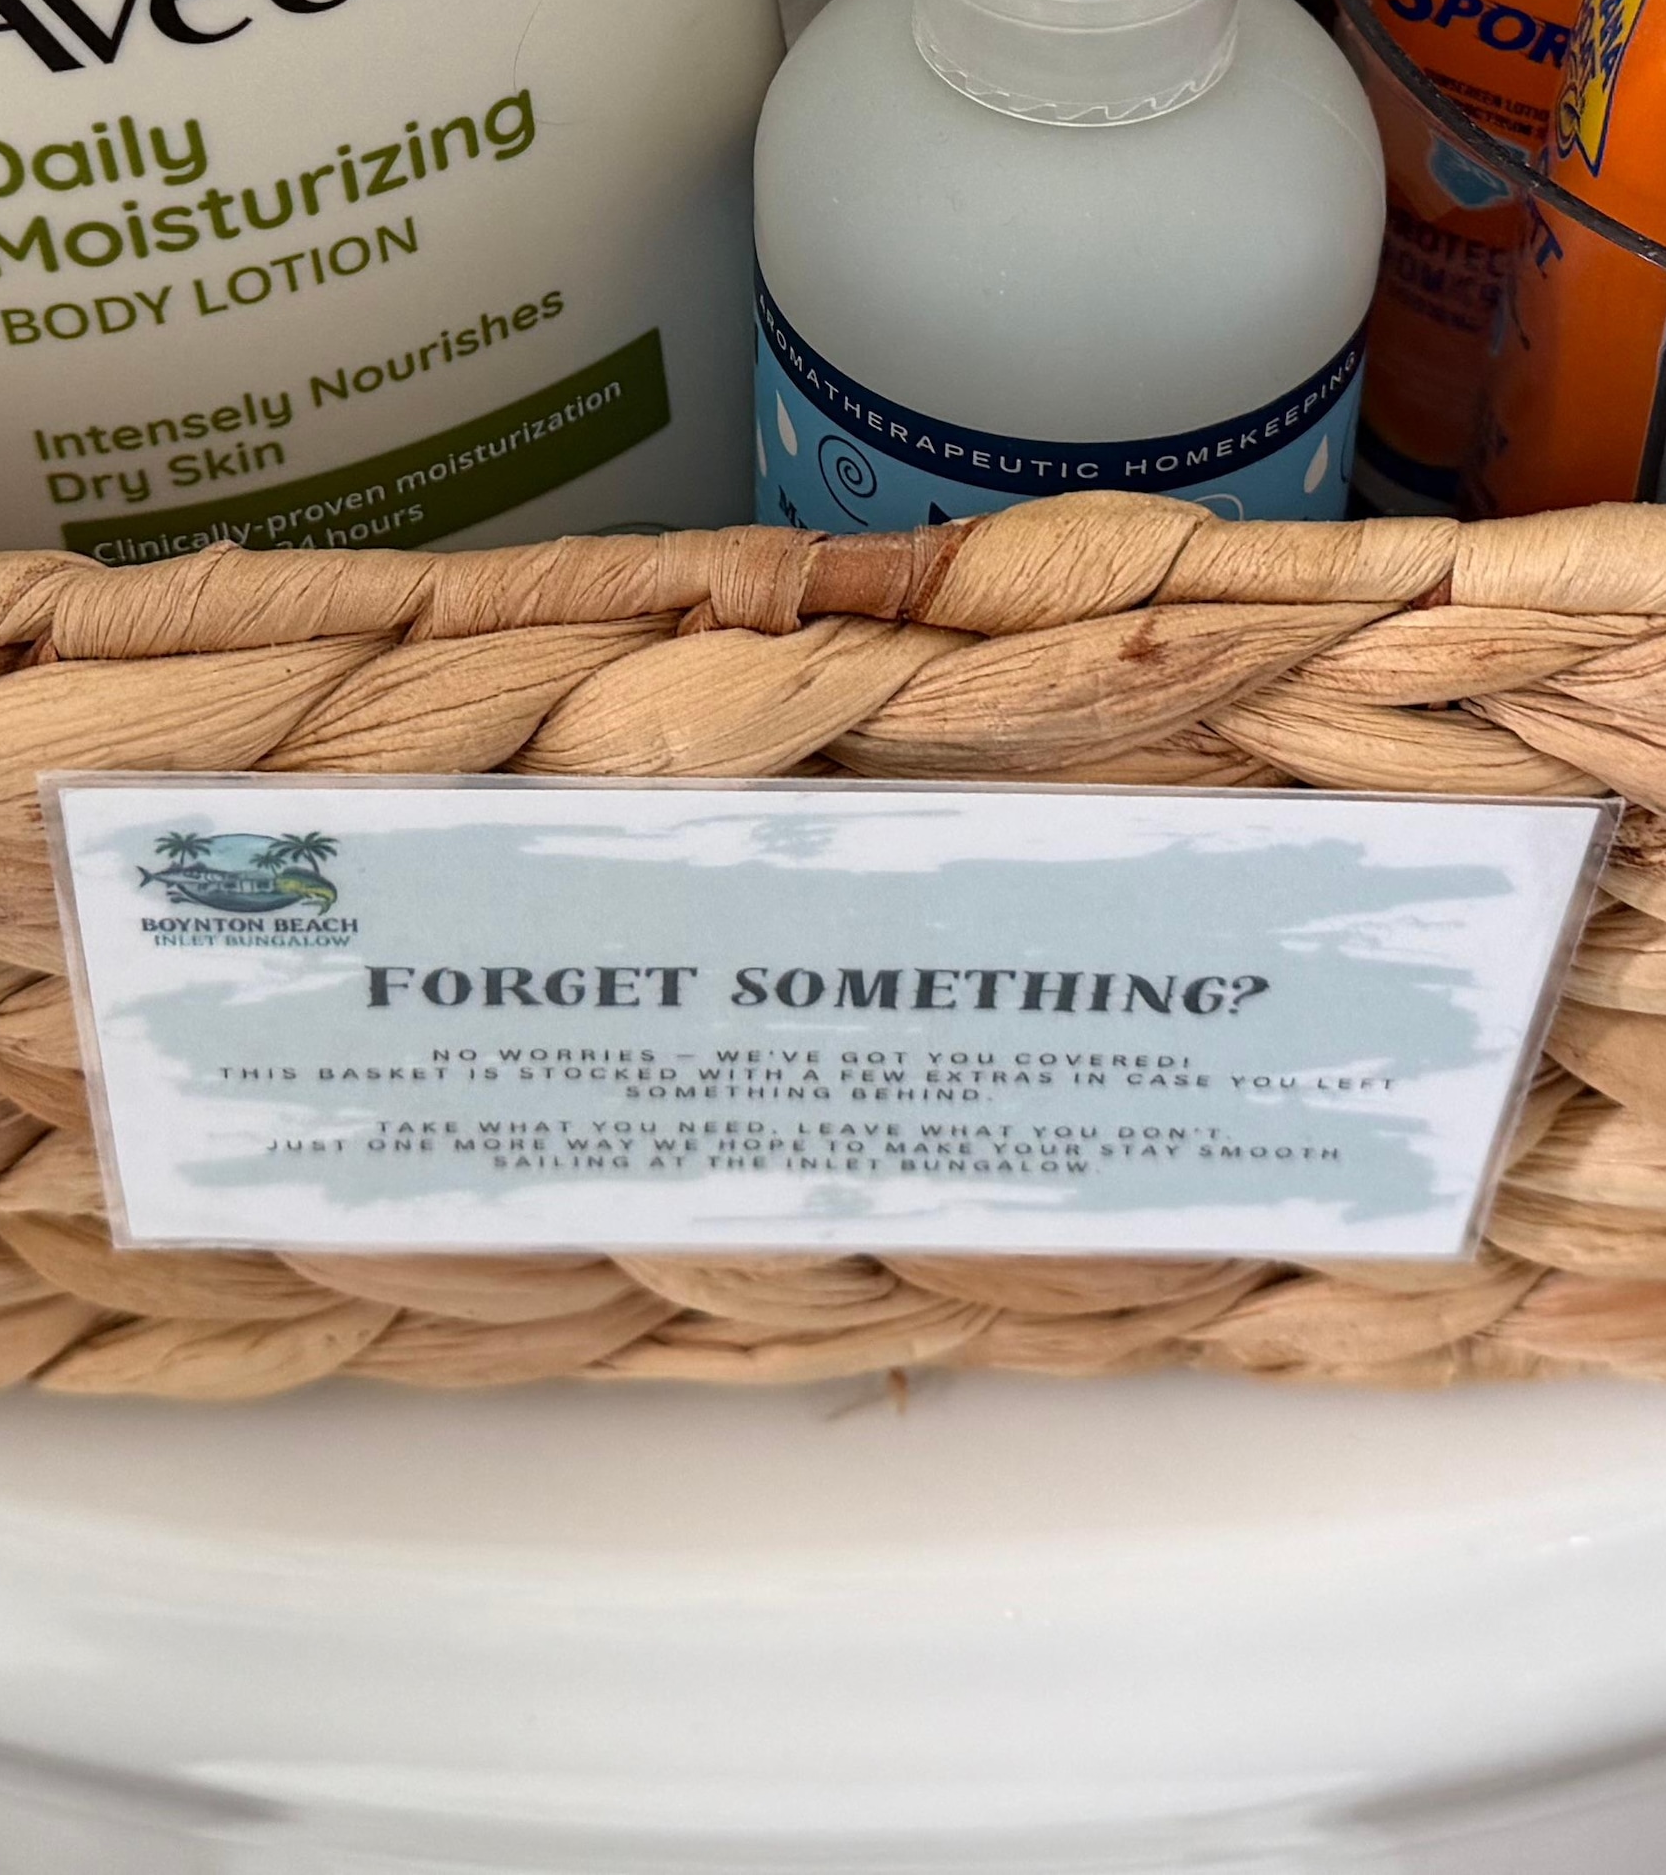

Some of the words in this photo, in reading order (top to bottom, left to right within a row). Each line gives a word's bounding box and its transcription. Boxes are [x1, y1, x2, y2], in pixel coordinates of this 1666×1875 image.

[1505, 96, 1551, 123] LOTIO
[0, 284, 175, 349] BODY
[192, 215, 422, 319] LOTION
[32, 385, 296, 466] Intensely
[309, 287, 568, 411] Nourishes
[757, 293, 1101, 480] AROMATHERAPEUTIC
[1124, 349, 1357, 477] HOMEKEEPING
[45, 464, 153, 510] Dry
[168, 433, 288, 490] Skin
[93, 481, 387, 565] Clinically-proven
[396, 377, 624, 495] moisturization
[325, 501, 425, 550] hours
[140, 917, 265, 933] BOYNTON
[274, 918, 359, 934] BEACH
[154, 934, 216, 947] INLET
[225, 934, 351, 948] BUNGALOW
[364, 964, 698, 1008] FORGET
[730, 966, 1270, 1015] SOMETHING?
[432, 1048, 478, 1062] NO
[498, 1048, 656, 1063] WORRIES
[717, 1048, 821, 1063] WE'VE
[841, 1050, 910, 1065] GOT
[927, 1050, 996, 1066] YOU
[1014, 1051, 1191, 1068] COVERED!
[219, 1067, 298, 1080] THIS
[318, 1067, 449, 1080] BASKET
[469, 1067, 499, 1081] IS
[519, 1067, 679, 1082] STOCKED
[697, 1068, 783, 1082] WITH
[802, 1068, 820, 1082] A
[840, 1068, 906, 1083] FEW
[926, 1069, 1054, 1085] EXTRAS
[1074, 1071, 1106, 1086] IN
[1126, 1072, 1211, 1088] CASE
[1230, 1076, 1297, 1089] YOU
[1317, 1078, 1397, 1090] LEFT
[625, 1085, 832, 1100] SOMETHING
[851, 1087, 995, 1102] BEHIND.
[376, 1120, 458, 1134] TAKE
[479, 1120, 573, 1134] WHAT
[592, 1121, 658, 1134] YOU
[798, 1122, 900, 1137] LEAVE
[921, 1123, 1013, 1138] WHAT
[1032, 1125, 1098, 1139] YOU
[265, 1139, 347, 1152] JUST
[367, 1138, 436, 1152] ONE
[454, 1138, 547, 1152] MORE
[566, 1138, 634, 1152] WAY
[653, 1138, 699, 1153] WE
[718, 1139, 807, 1153] HOPE
[827, 1139, 866, 1154] TO
[884, 1140, 974, 1155] MAKE
[993, 1141, 1082, 1157] YOUR
[1100, 1143, 1181, 1158] STAY
[1198, 1145, 1340, 1161] SMOOTH
[493, 1155, 630, 1169] SAILING
[648, 1155, 686, 1169] AT
[707, 1156, 767, 1170] THE
[785, 1156, 881, 1172] INLET
